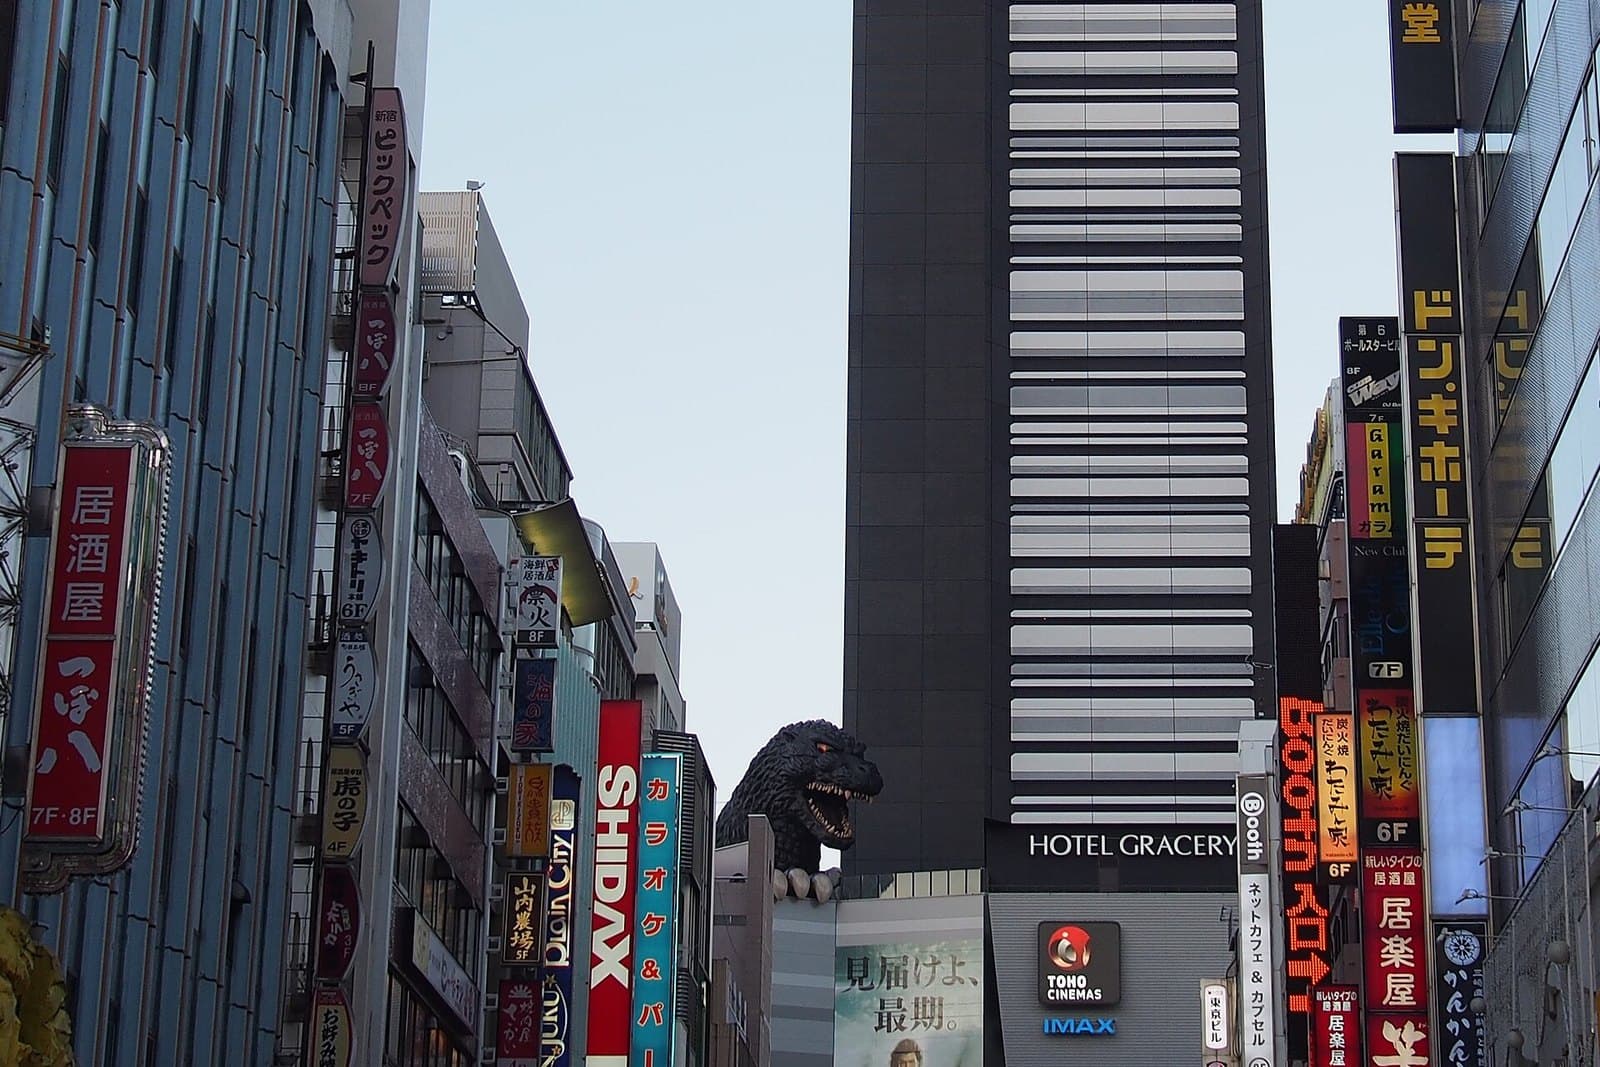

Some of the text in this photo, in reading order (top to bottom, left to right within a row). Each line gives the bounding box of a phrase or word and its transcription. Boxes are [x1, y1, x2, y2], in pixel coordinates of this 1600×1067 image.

[1402, 3, 1441, 43] 堂
[375, 110, 398, 122] 新宿
[1377, 324, 1386, 336] 6
[359, 318, 389, 370] つぼ八
[1346, 367, 1361, 375] 8F
[1413, 289, 1463, 570] ドン・キホーテ
[350, 428, 383, 481] つぼ八
[350, 493, 373, 503] 7F
[61, 485, 114, 623] 居酒屋
[349, 538, 369, 593] ヤキトリ
[523, 559, 546, 571] 海鮮
[341, 603, 368, 618] 6F
[528, 631, 545, 642] 8F
[1371, 663, 1401, 677] 7F
[36, 655, 102, 774] つぼ八
[338, 724, 356, 735] 5F
[1336, 717, 1350, 757] 炭火焼
[332, 776, 361, 832] 虎の子
[1240, 792, 1265, 861] Booth
[1376, 822, 1409, 843] 6F
[327, 841, 347, 851] 4F
[1029, 833, 1238, 857] HOTEL GRACERY
[590, 764, 638, 989] SHIDAX
[1328, 864, 1351, 877] 6F
[1374, 871, 1416, 887] 居酒屋
[509, 876, 537, 950] 山内農場
[1248, 882, 1263, 963] ネットカフェ
[516, 950, 529, 960] 5F
[1379, 896, 1417, 1007] 居楽屋
[844, 954, 980, 993] 見届けよ、
[1047, 975, 1087, 989] TOHO
[1251, 971, 1264, 984] &
[1047, 988, 1102, 1001] CINEMAS
[873, 995, 958, 1033] 最期。
[1043, 1017, 1117, 1035] IMAX
[1210, 997, 1222, 1044] 東京ビル
[1328, 1015, 1346, 1066] 居楽屋
